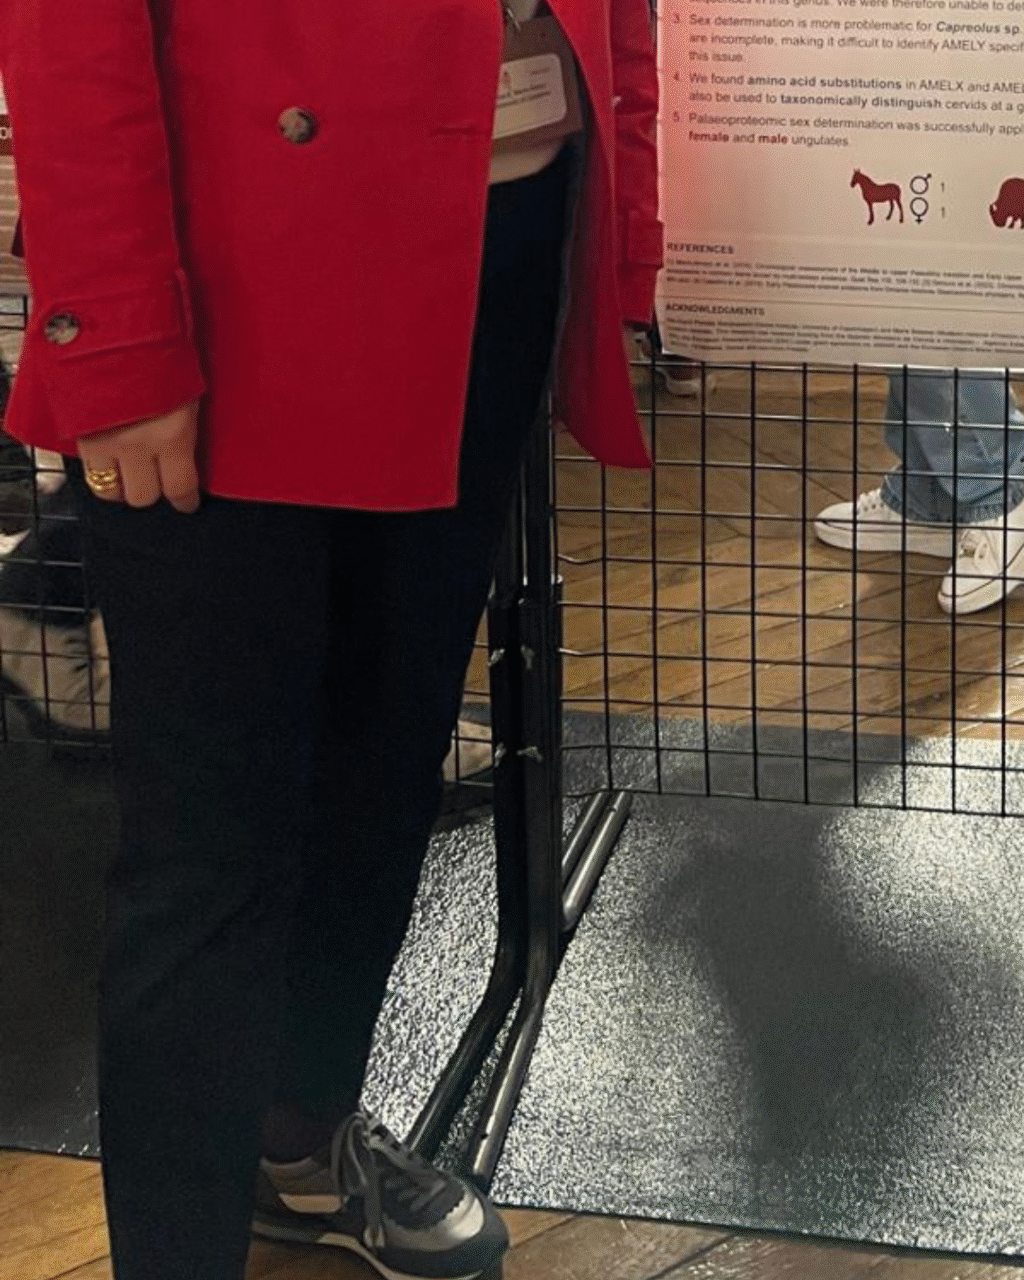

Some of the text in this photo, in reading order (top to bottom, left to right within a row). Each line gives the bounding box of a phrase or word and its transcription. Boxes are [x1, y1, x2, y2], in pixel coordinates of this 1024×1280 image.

[746, 75, 902, 90] amino acid substitutions
[779, 93, 942, 111] taxonomically distinguish
